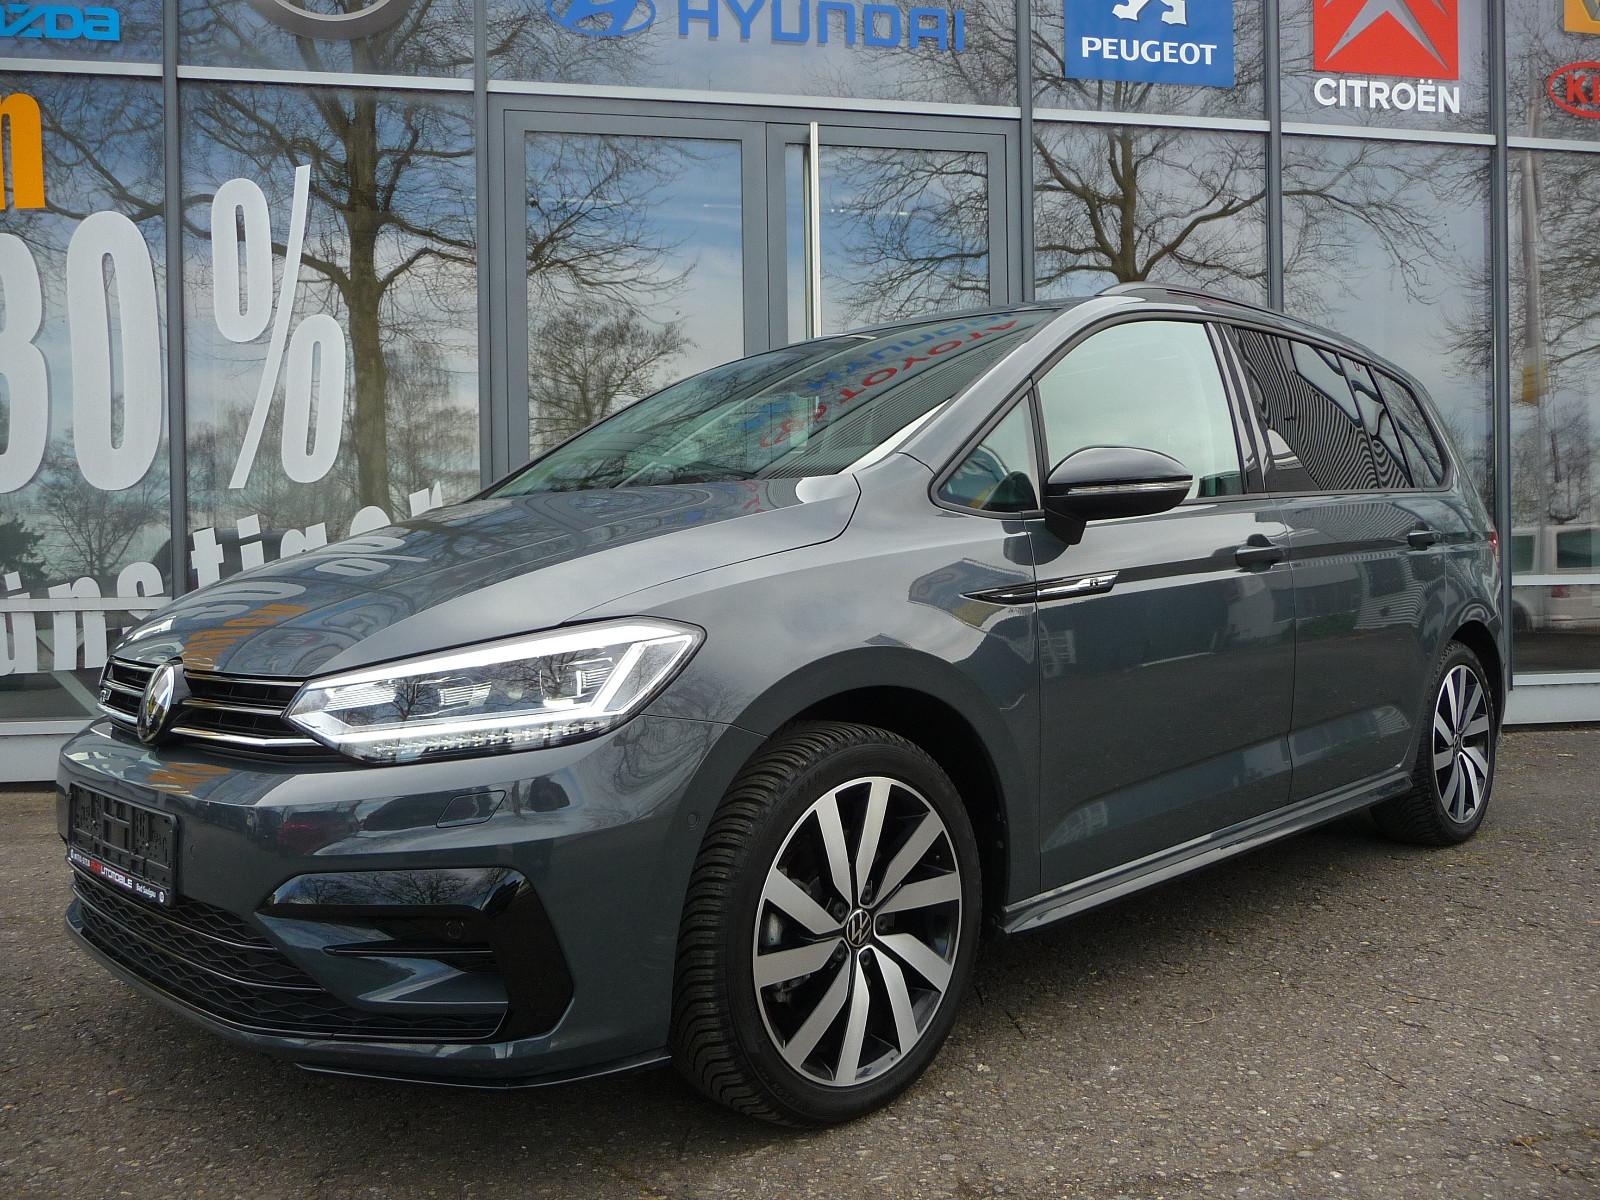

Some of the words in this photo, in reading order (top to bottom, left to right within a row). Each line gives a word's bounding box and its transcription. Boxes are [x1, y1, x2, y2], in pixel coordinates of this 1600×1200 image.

[678, 0, 965, 51] HYUNDAI
[1081, 36, 1217, 65] PEUGEOT
[1314, 77, 1460, 114] CITROËN
